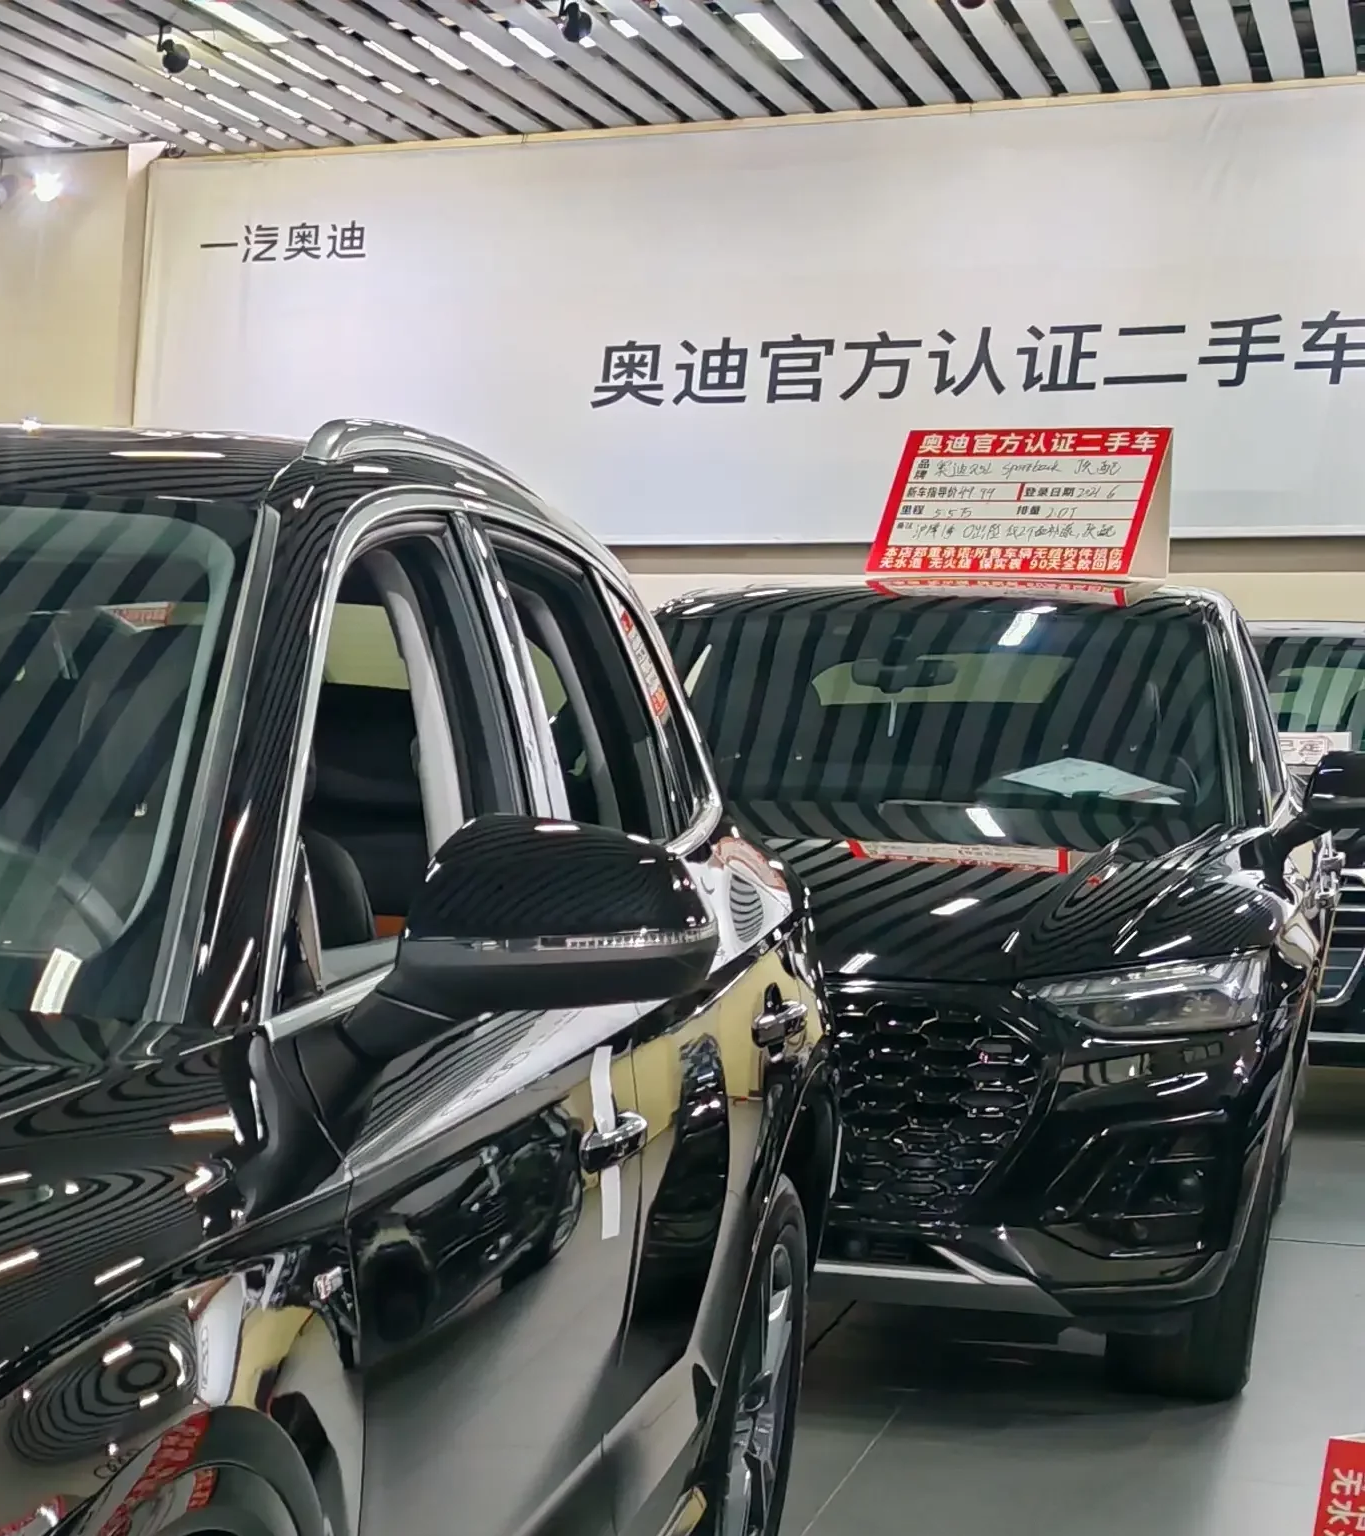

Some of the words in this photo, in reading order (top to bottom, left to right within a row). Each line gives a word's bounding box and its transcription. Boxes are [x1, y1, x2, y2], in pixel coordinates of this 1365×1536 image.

[199, 220, 366, 263] 一汽奥迪
[590, 310, 1365, 408] 奥迪官方认证二手车
[917, 432, 1159, 454] 奥迪官方认证二手车
[913, 459, 930, 480] 品牌
[906, 486, 957, 499] 新车指导价
[1024, 487, 1075, 497] 登录日期
[1016, 505, 1041, 515] 排量
